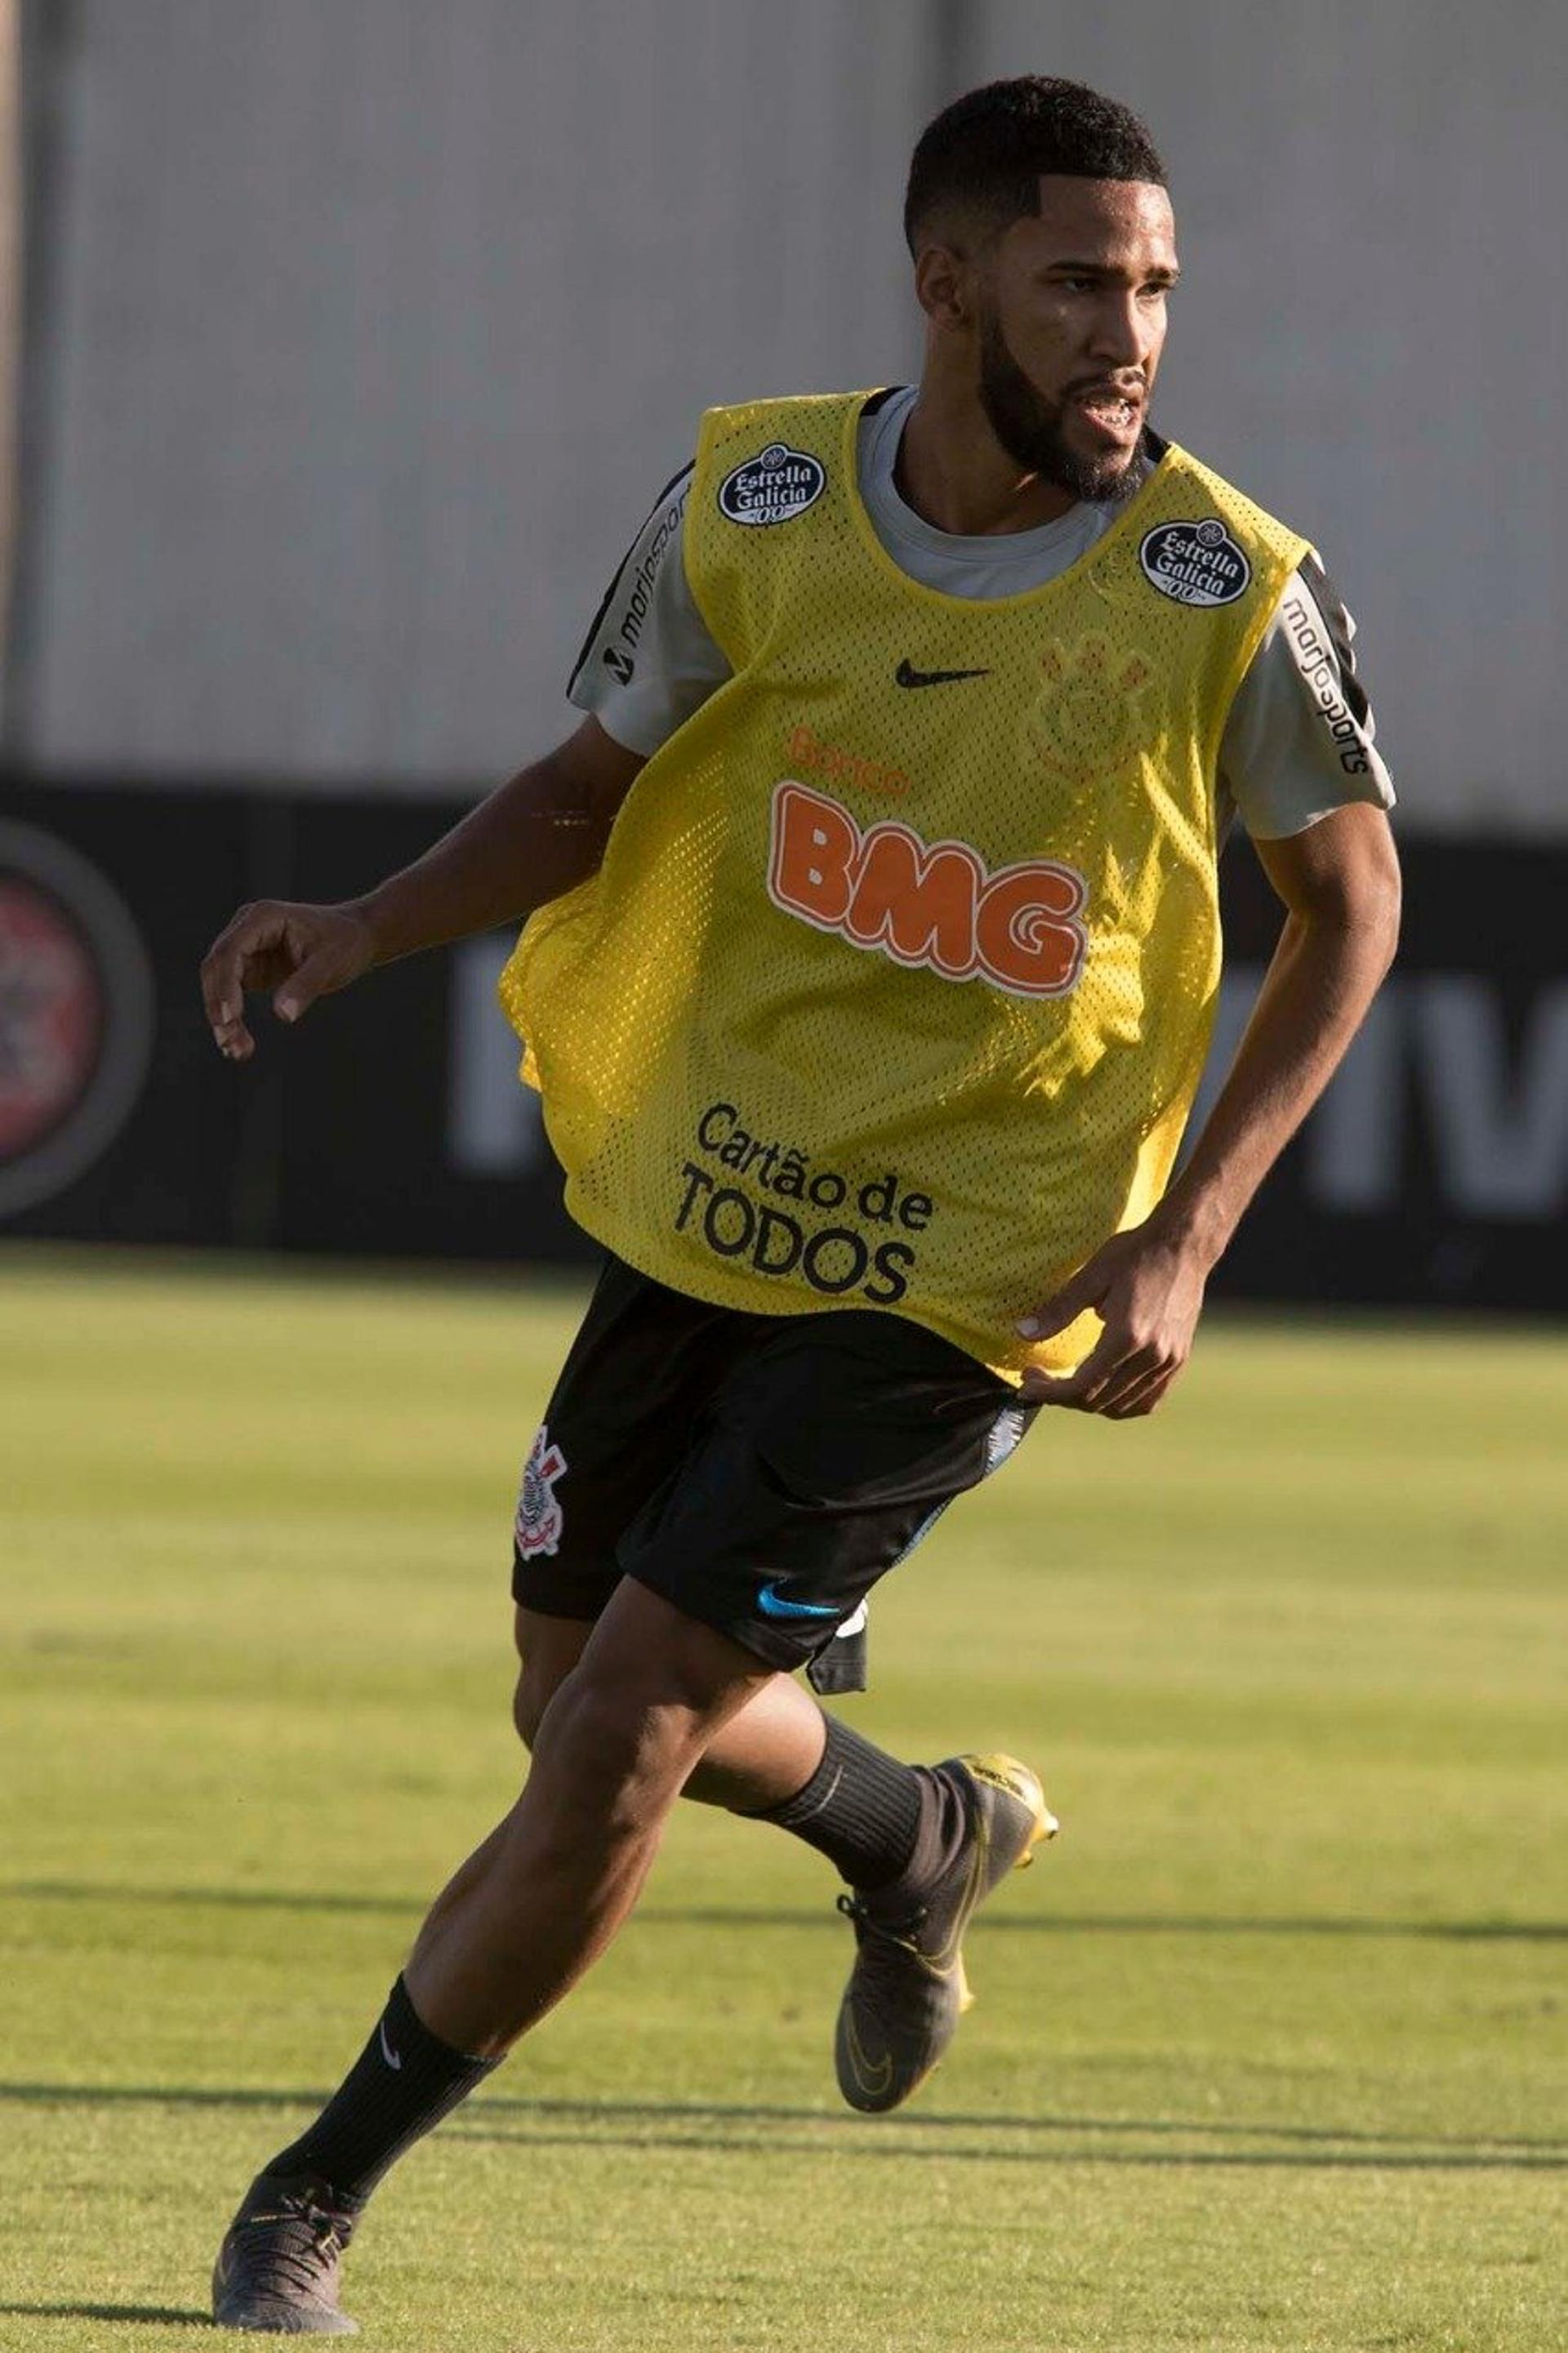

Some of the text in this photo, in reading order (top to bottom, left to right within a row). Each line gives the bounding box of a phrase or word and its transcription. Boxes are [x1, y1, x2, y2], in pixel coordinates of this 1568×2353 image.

[735, 466, 812, 492] Estrella
[737, 484, 807, 510] Galicia
[1157, 552, 1224, 595] Galicia
[1160, 531, 1239, 577] Estrella
[1283, 598, 1368, 775] marjosports
[790, 724, 911, 795] Banco
[770, 782, 1086, 996] BMG
[697, 1103, 933, 1230] Cartão de
[674, 1161, 916, 1304] TODOS
